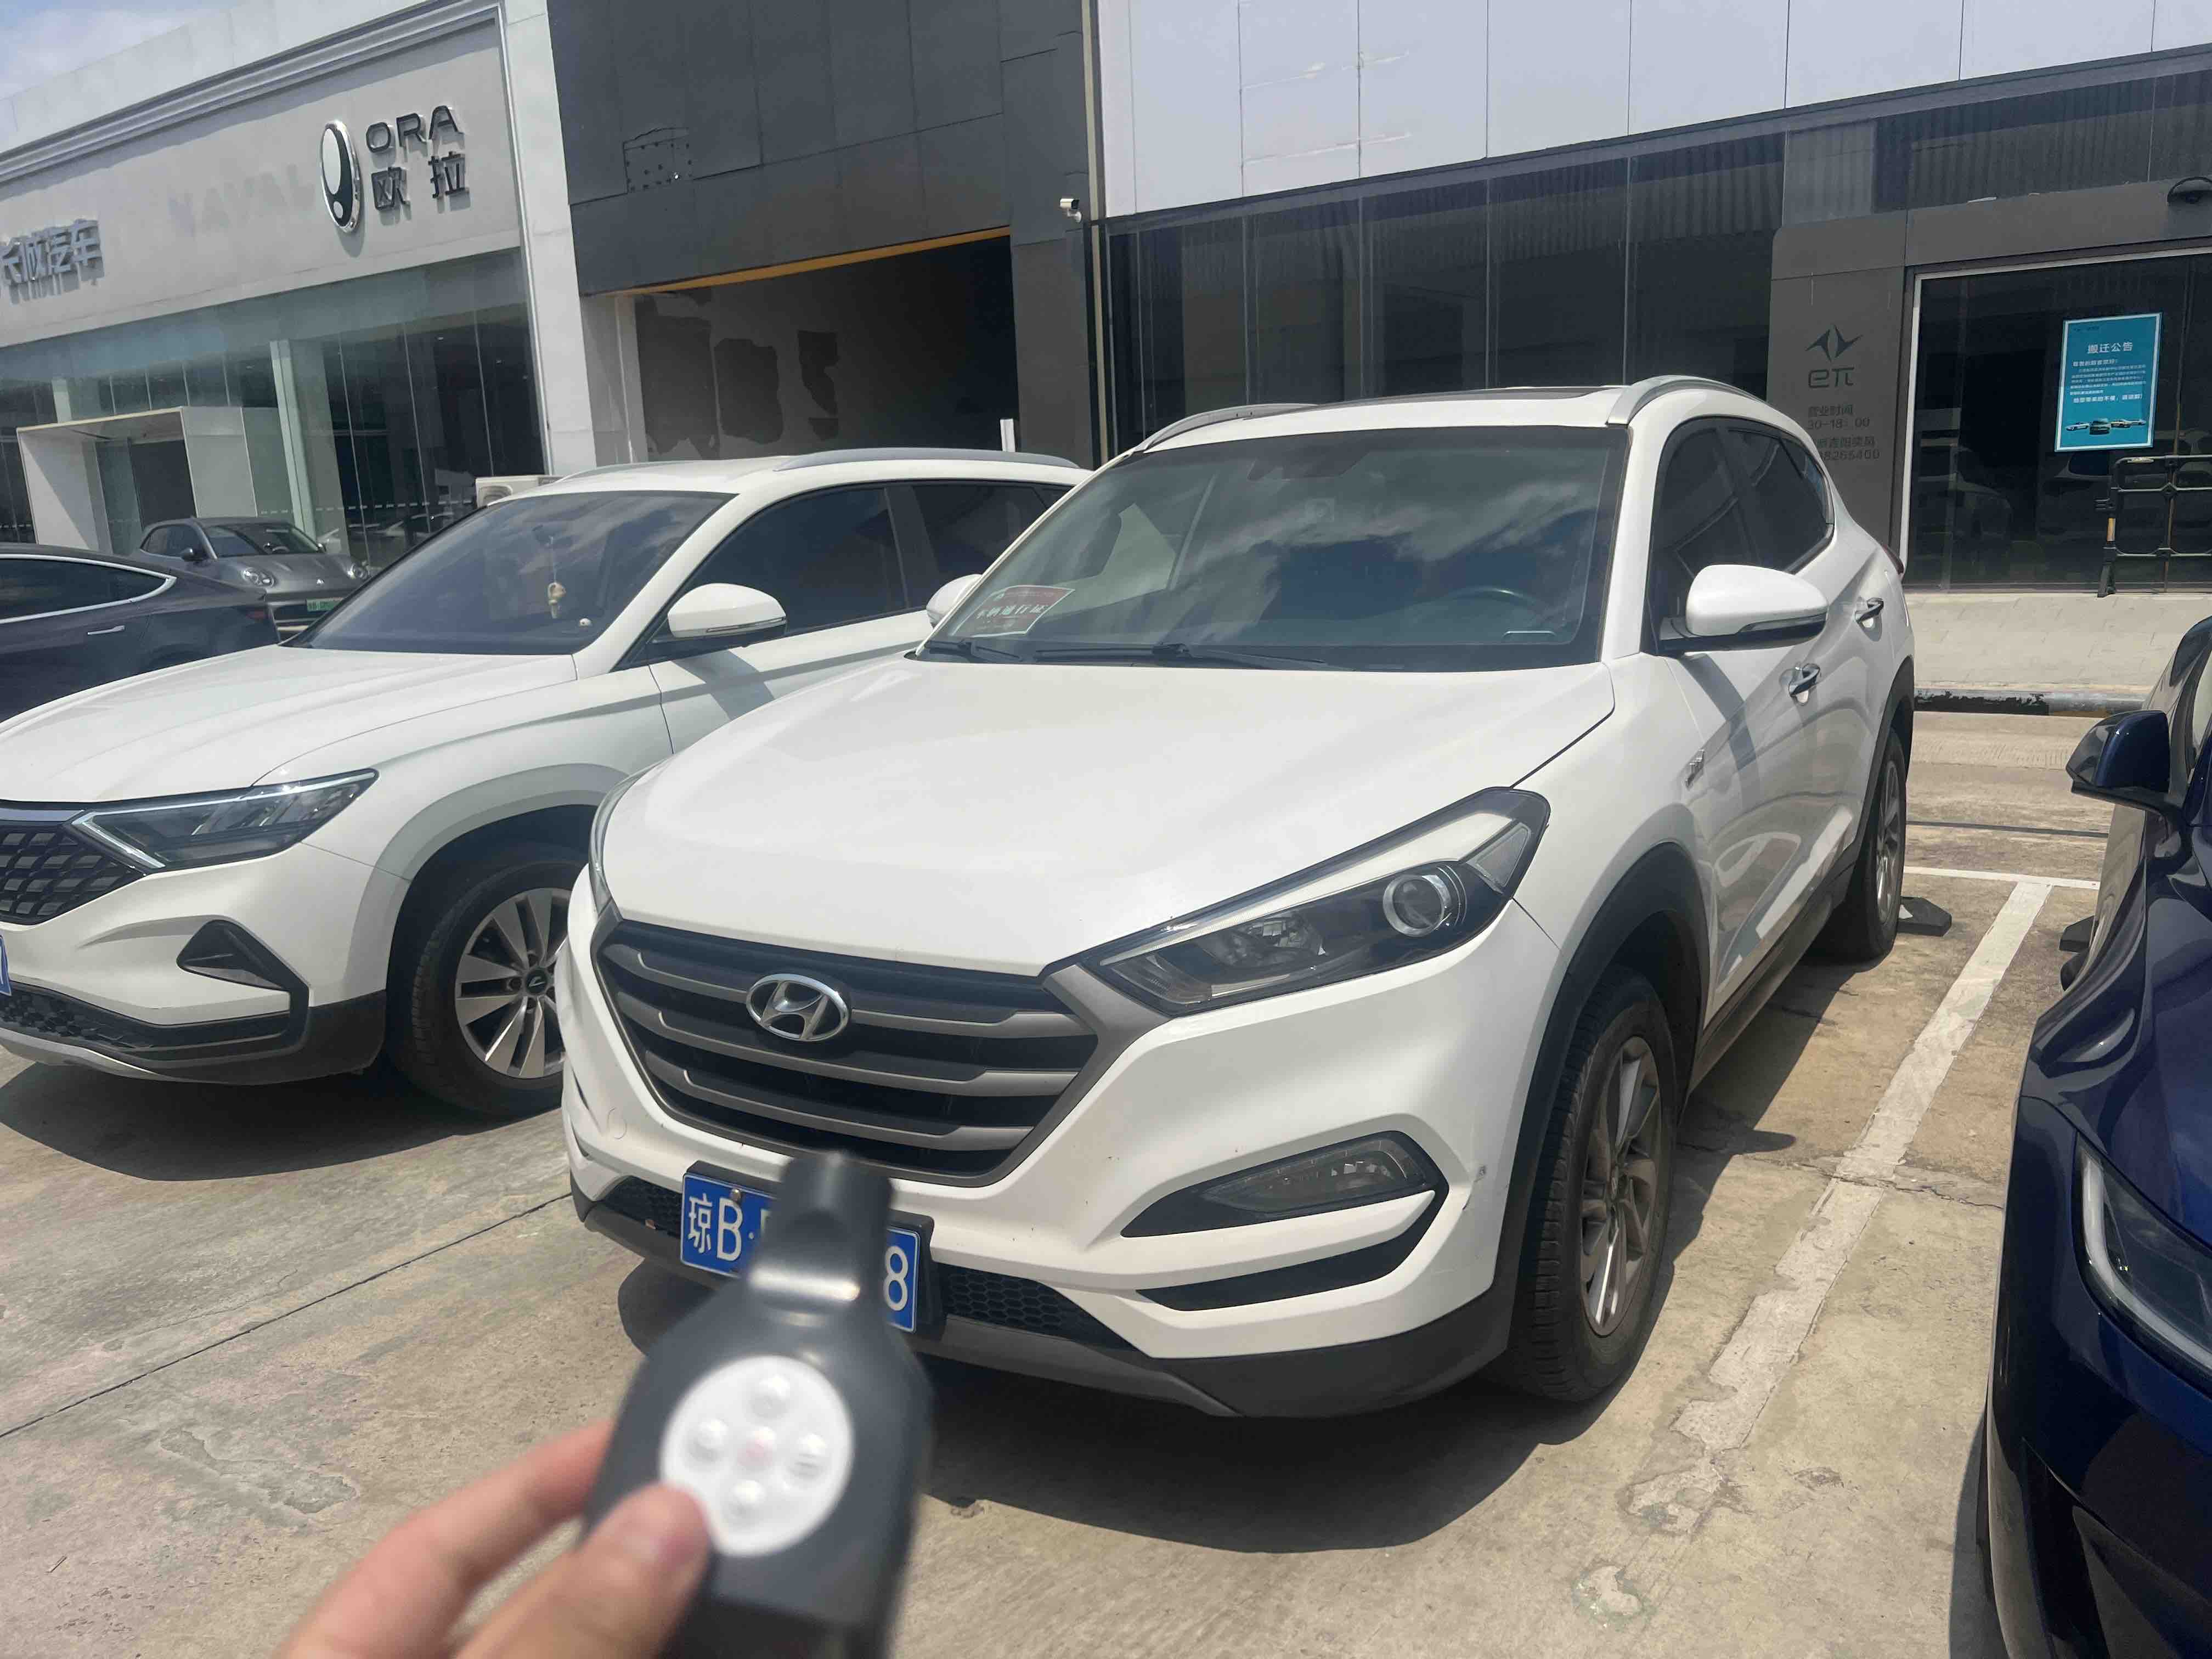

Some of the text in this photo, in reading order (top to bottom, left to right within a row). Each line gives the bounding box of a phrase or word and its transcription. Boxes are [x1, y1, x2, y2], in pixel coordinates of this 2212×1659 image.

[365, 105, 462, 154] ORA
[371, 151, 469, 211] 欧拉
[2087, 341, 2133, 354] 搬迁公告
